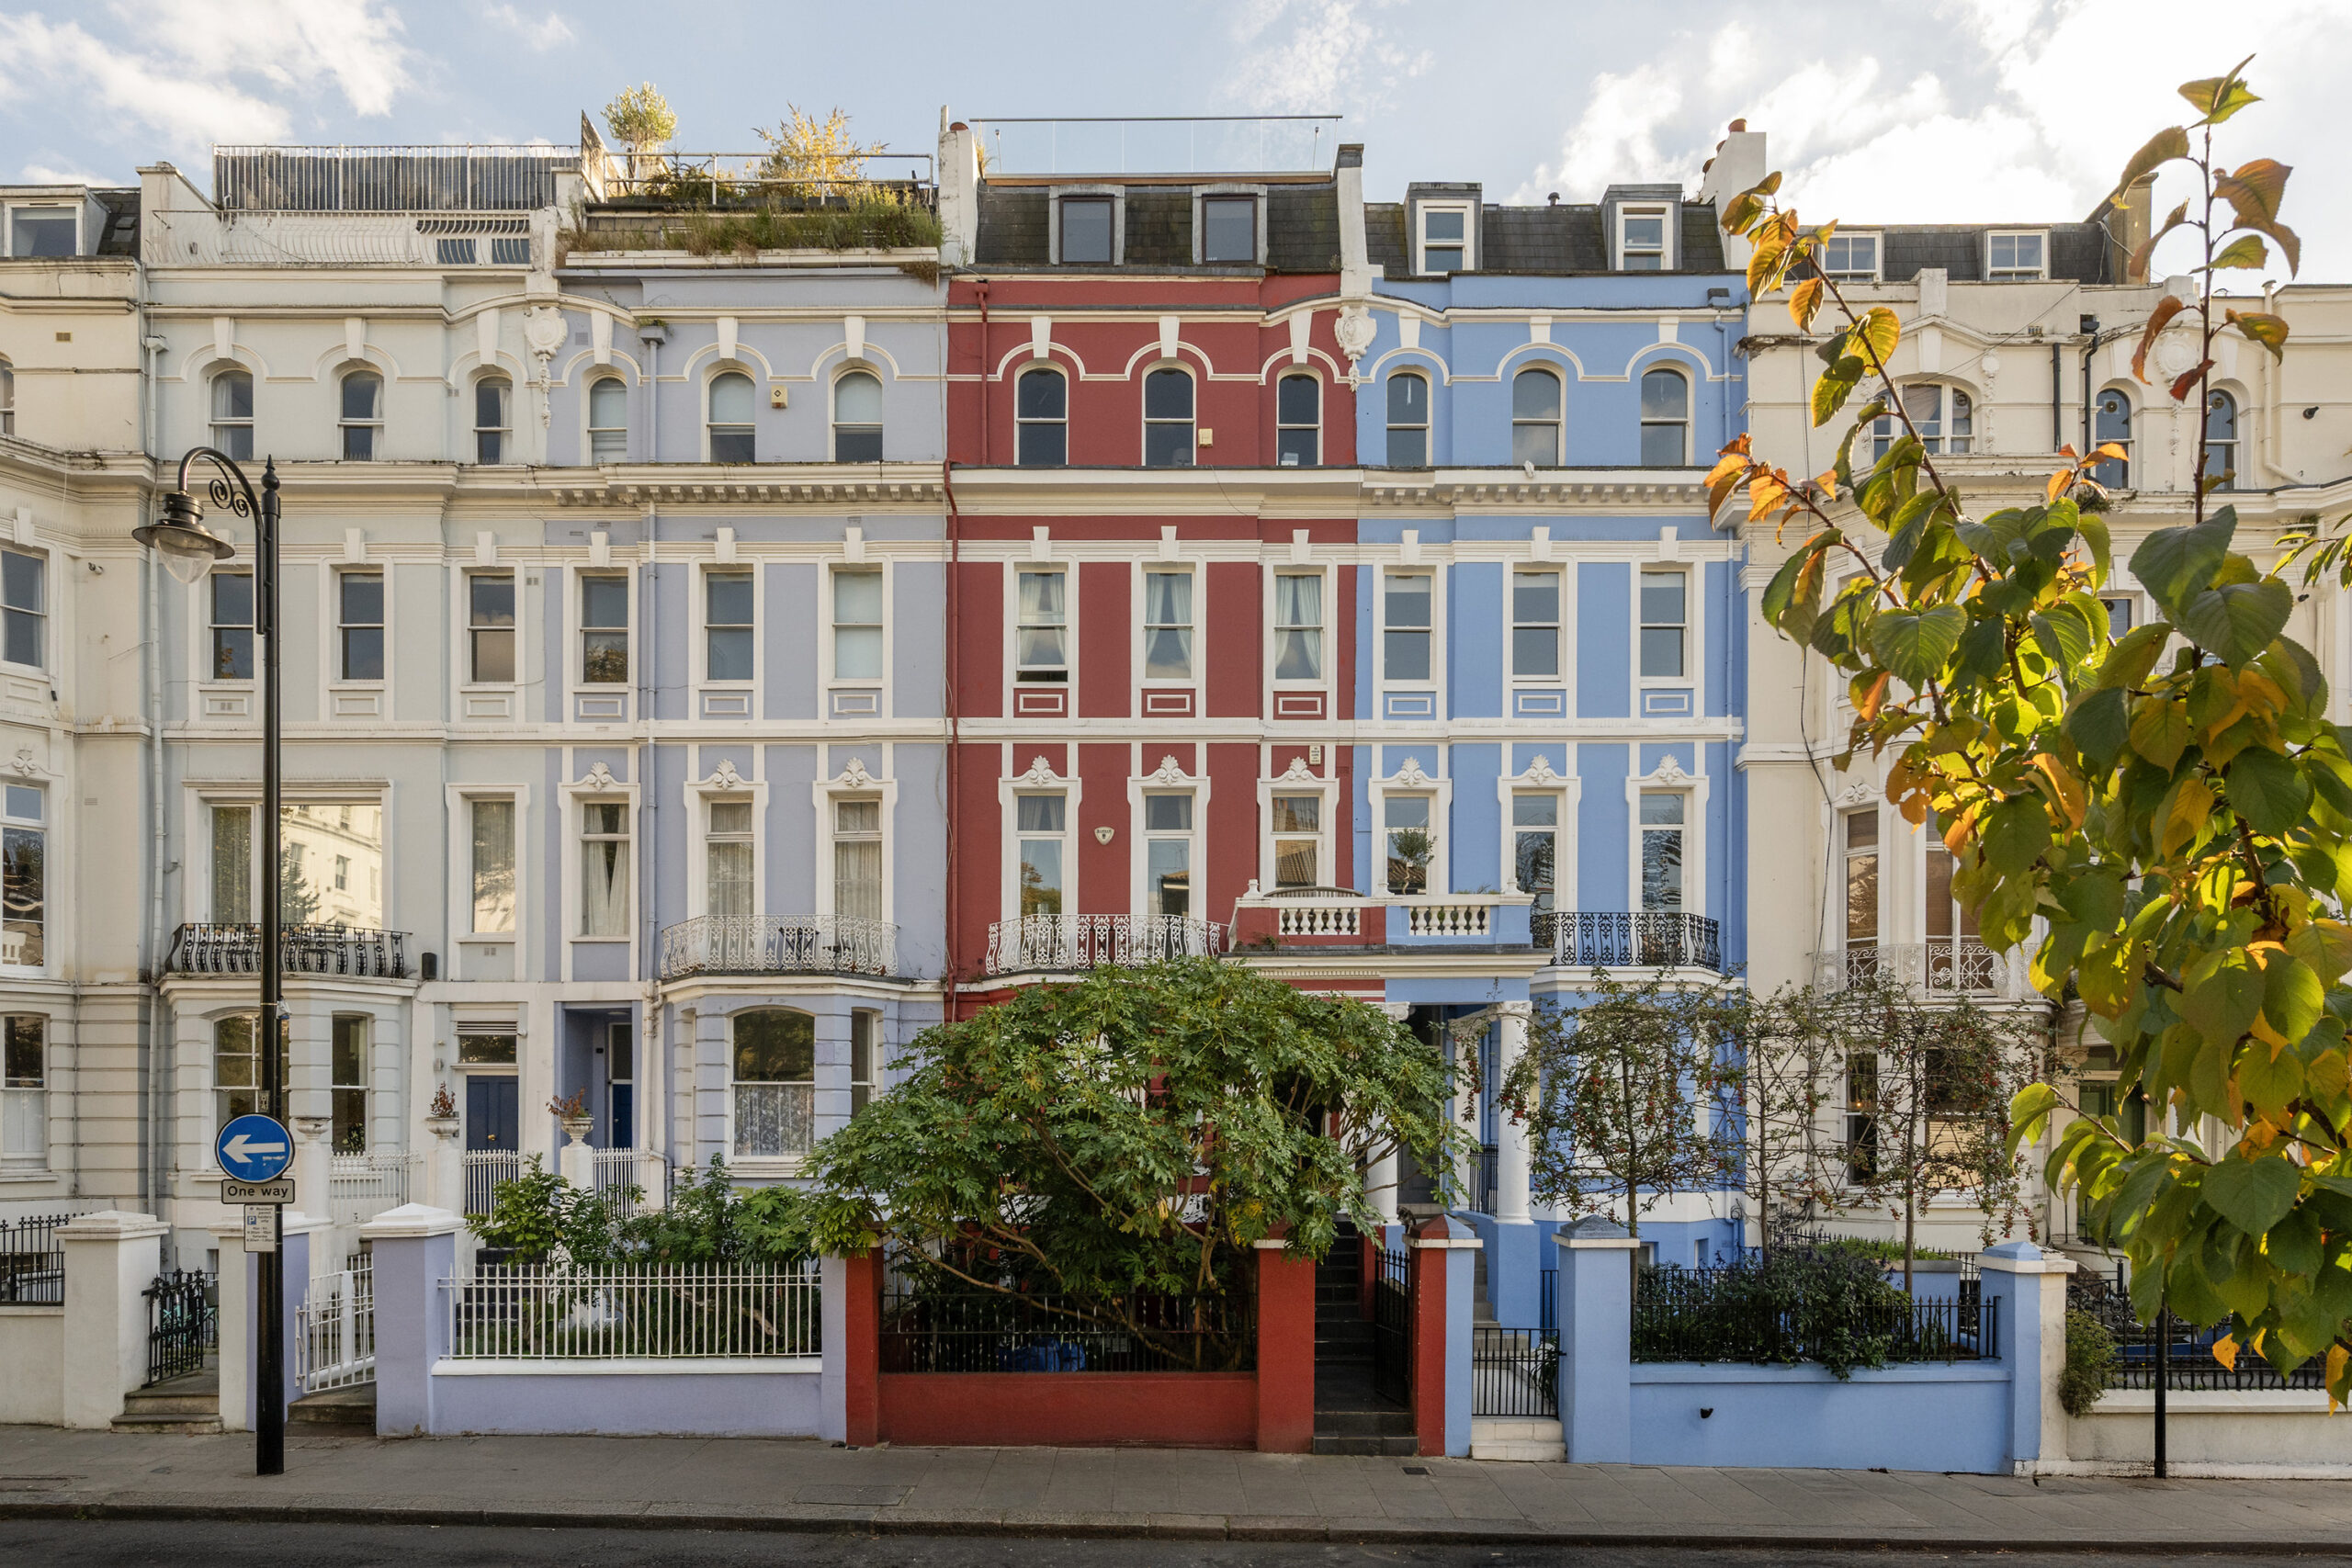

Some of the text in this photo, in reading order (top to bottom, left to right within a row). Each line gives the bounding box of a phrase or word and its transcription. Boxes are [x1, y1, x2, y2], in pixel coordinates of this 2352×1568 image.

[227, 1186, 288, 1198] One way
[249, 1216, 254, 1224] P
